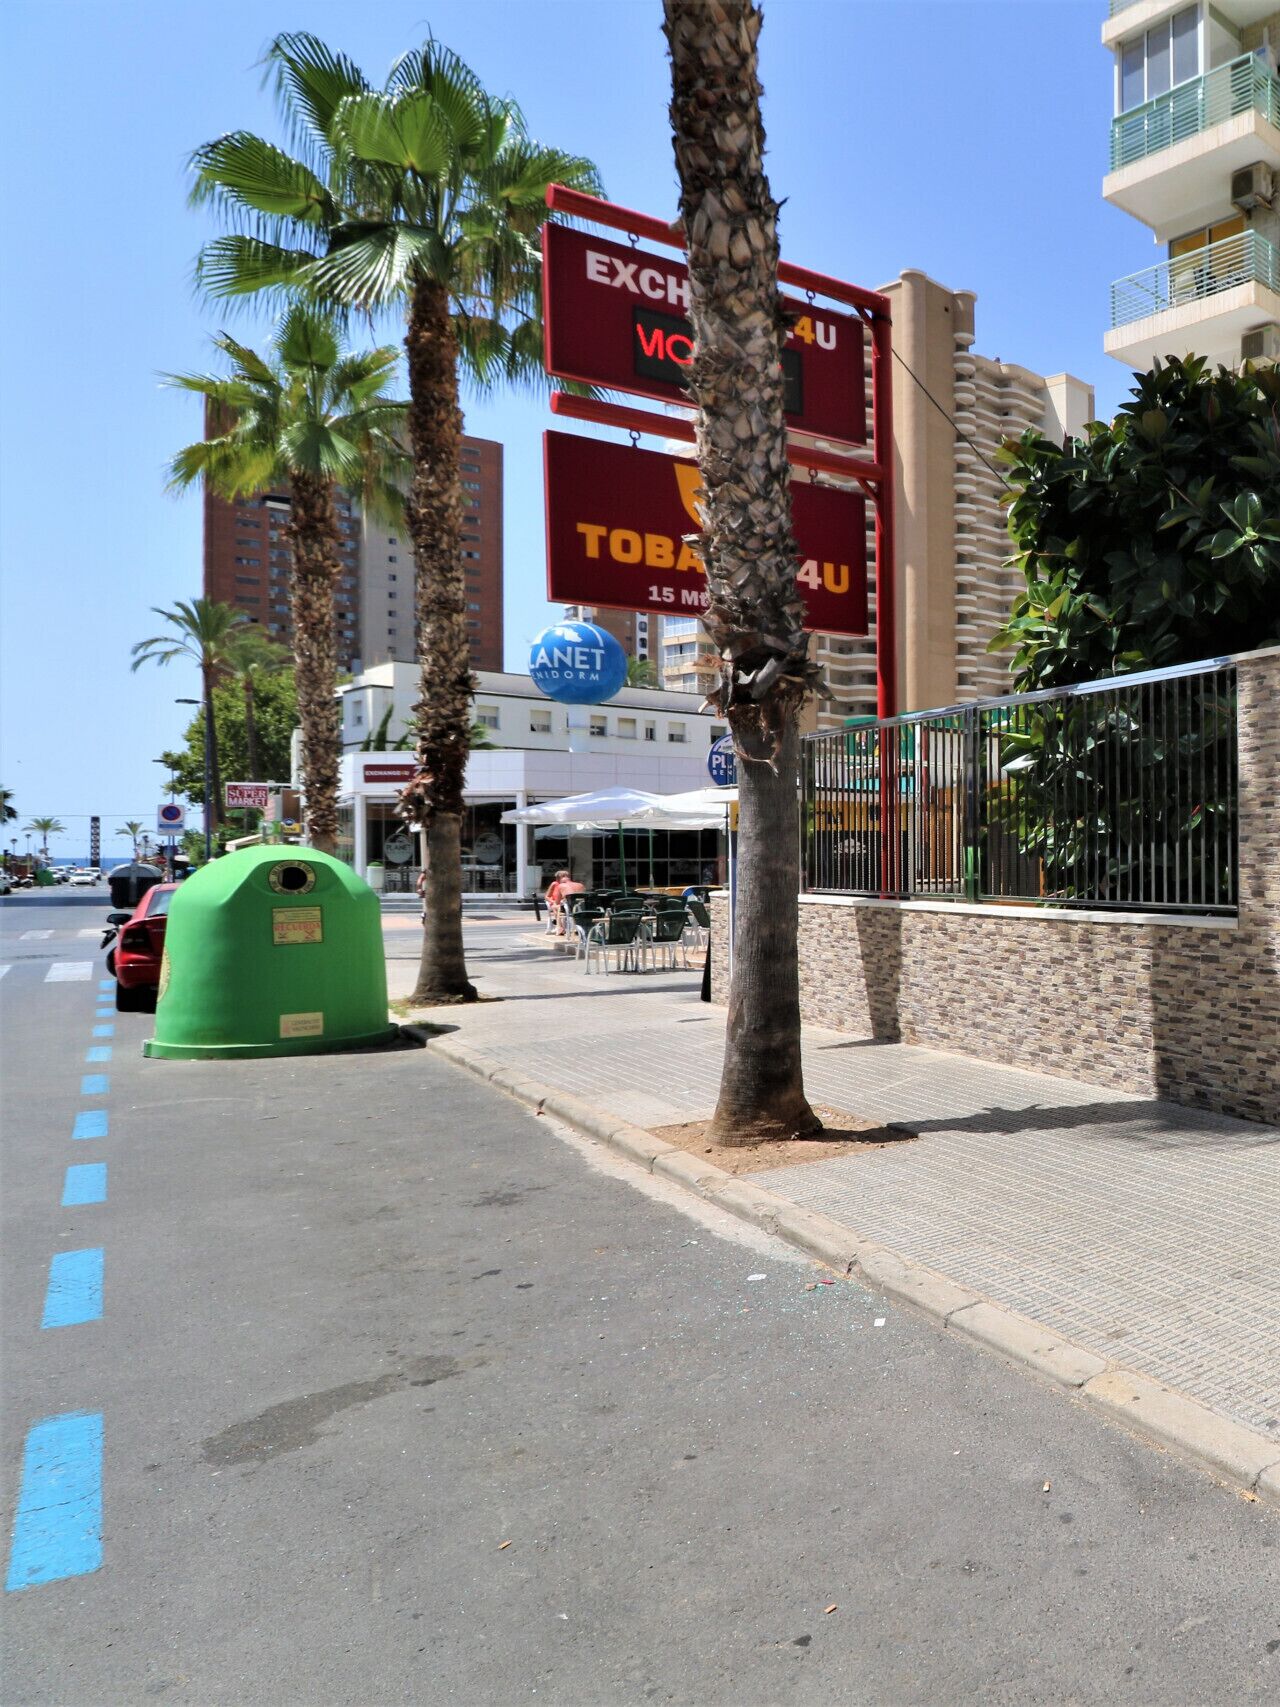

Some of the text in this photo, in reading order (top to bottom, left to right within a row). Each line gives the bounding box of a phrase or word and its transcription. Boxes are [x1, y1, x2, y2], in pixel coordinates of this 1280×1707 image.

[585, 249, 837, 351] EXCH4U
[576, 522, 849, 594] TOBA4U
[648, 585, 708, 607] 15 Mt
[528, 646, 605, 671] LANET
[532, 670, 600, 681] ENIDORM
[228, 789, 267, 798] SUPER
[228, 797, 267, 806] MARKET
